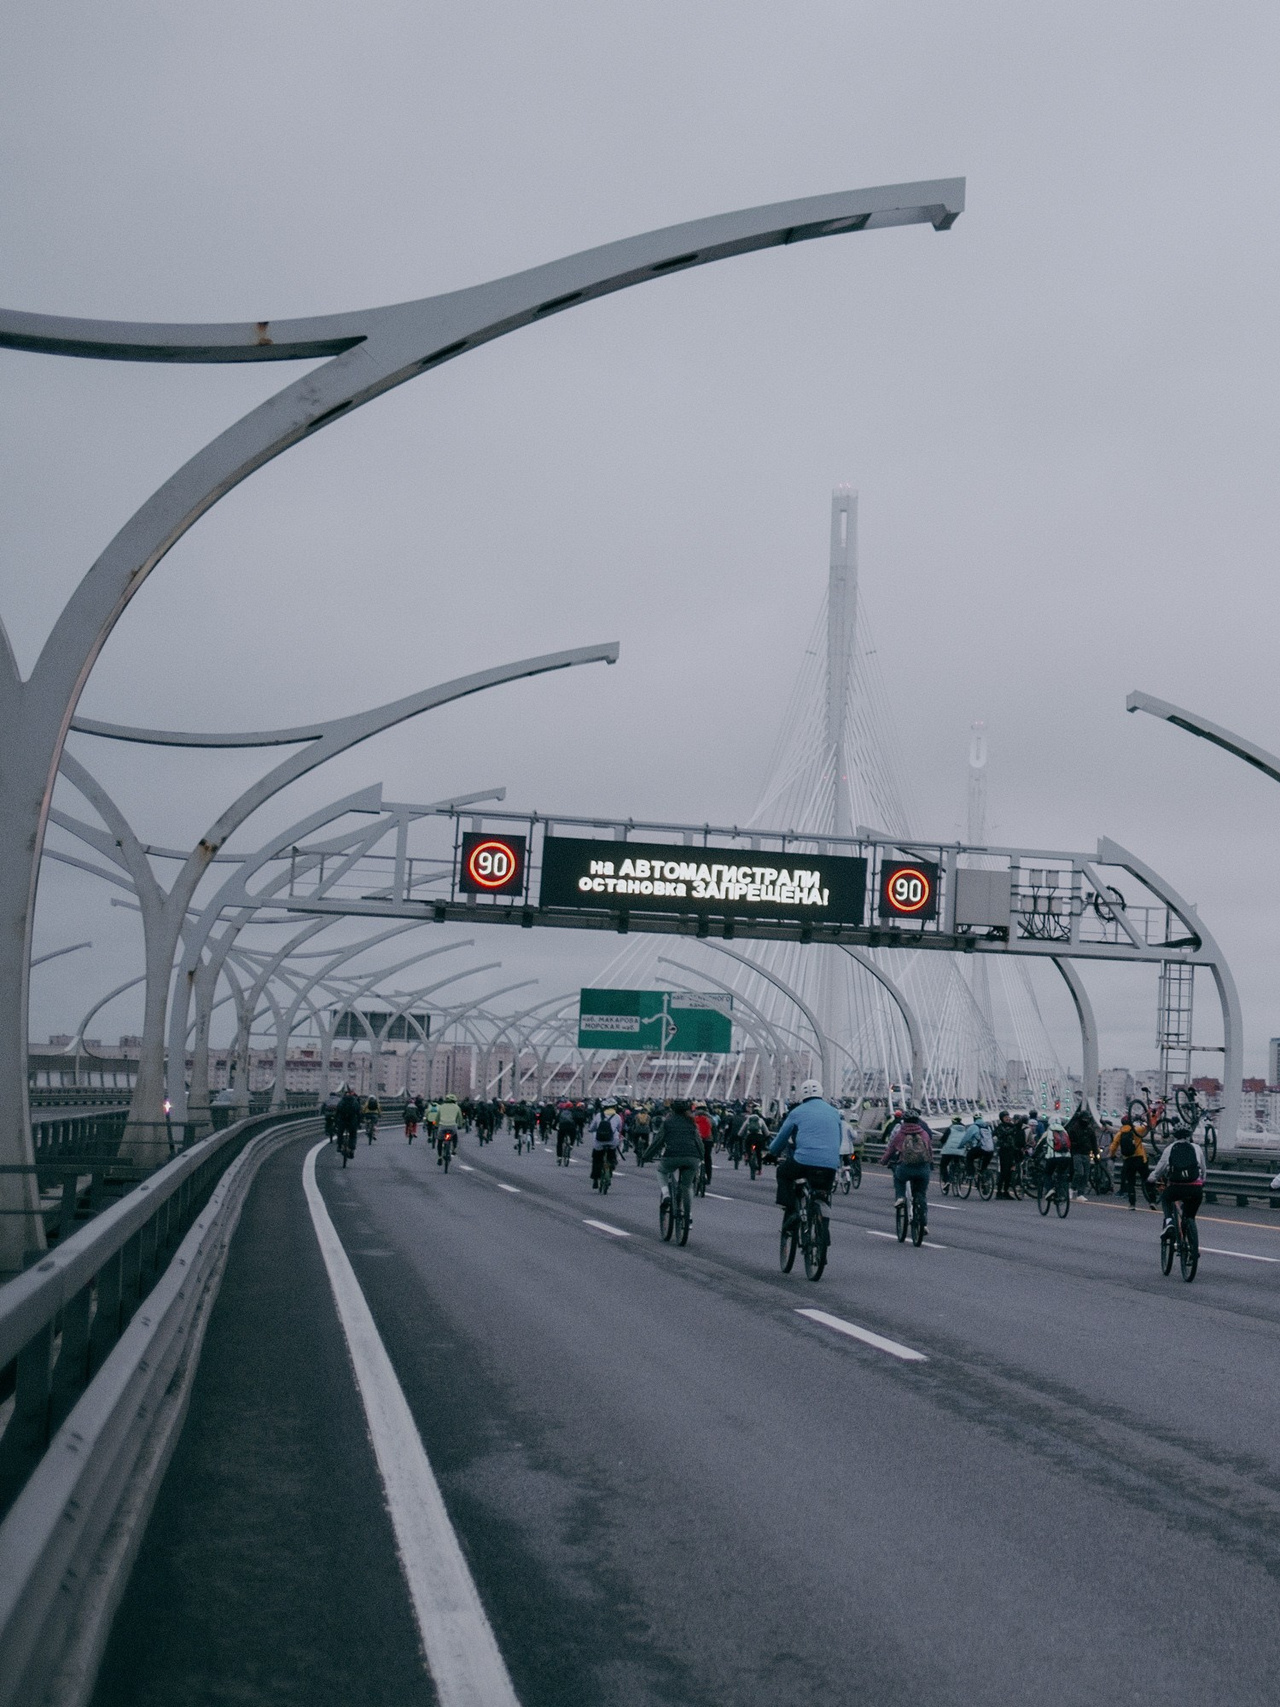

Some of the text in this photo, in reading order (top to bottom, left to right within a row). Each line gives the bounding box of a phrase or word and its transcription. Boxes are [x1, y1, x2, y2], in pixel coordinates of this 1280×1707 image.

[478, 851, 508, 877] 90
[589, 858, 821, 888] на АВТОМАГИСТРАЛИ
[578, 876, 830, 906] остановка ЗАПРЕЩЕНА!
[895, 878, 922, 903] 90
[598, 1016, 639, 1024] МАКАРОВА
